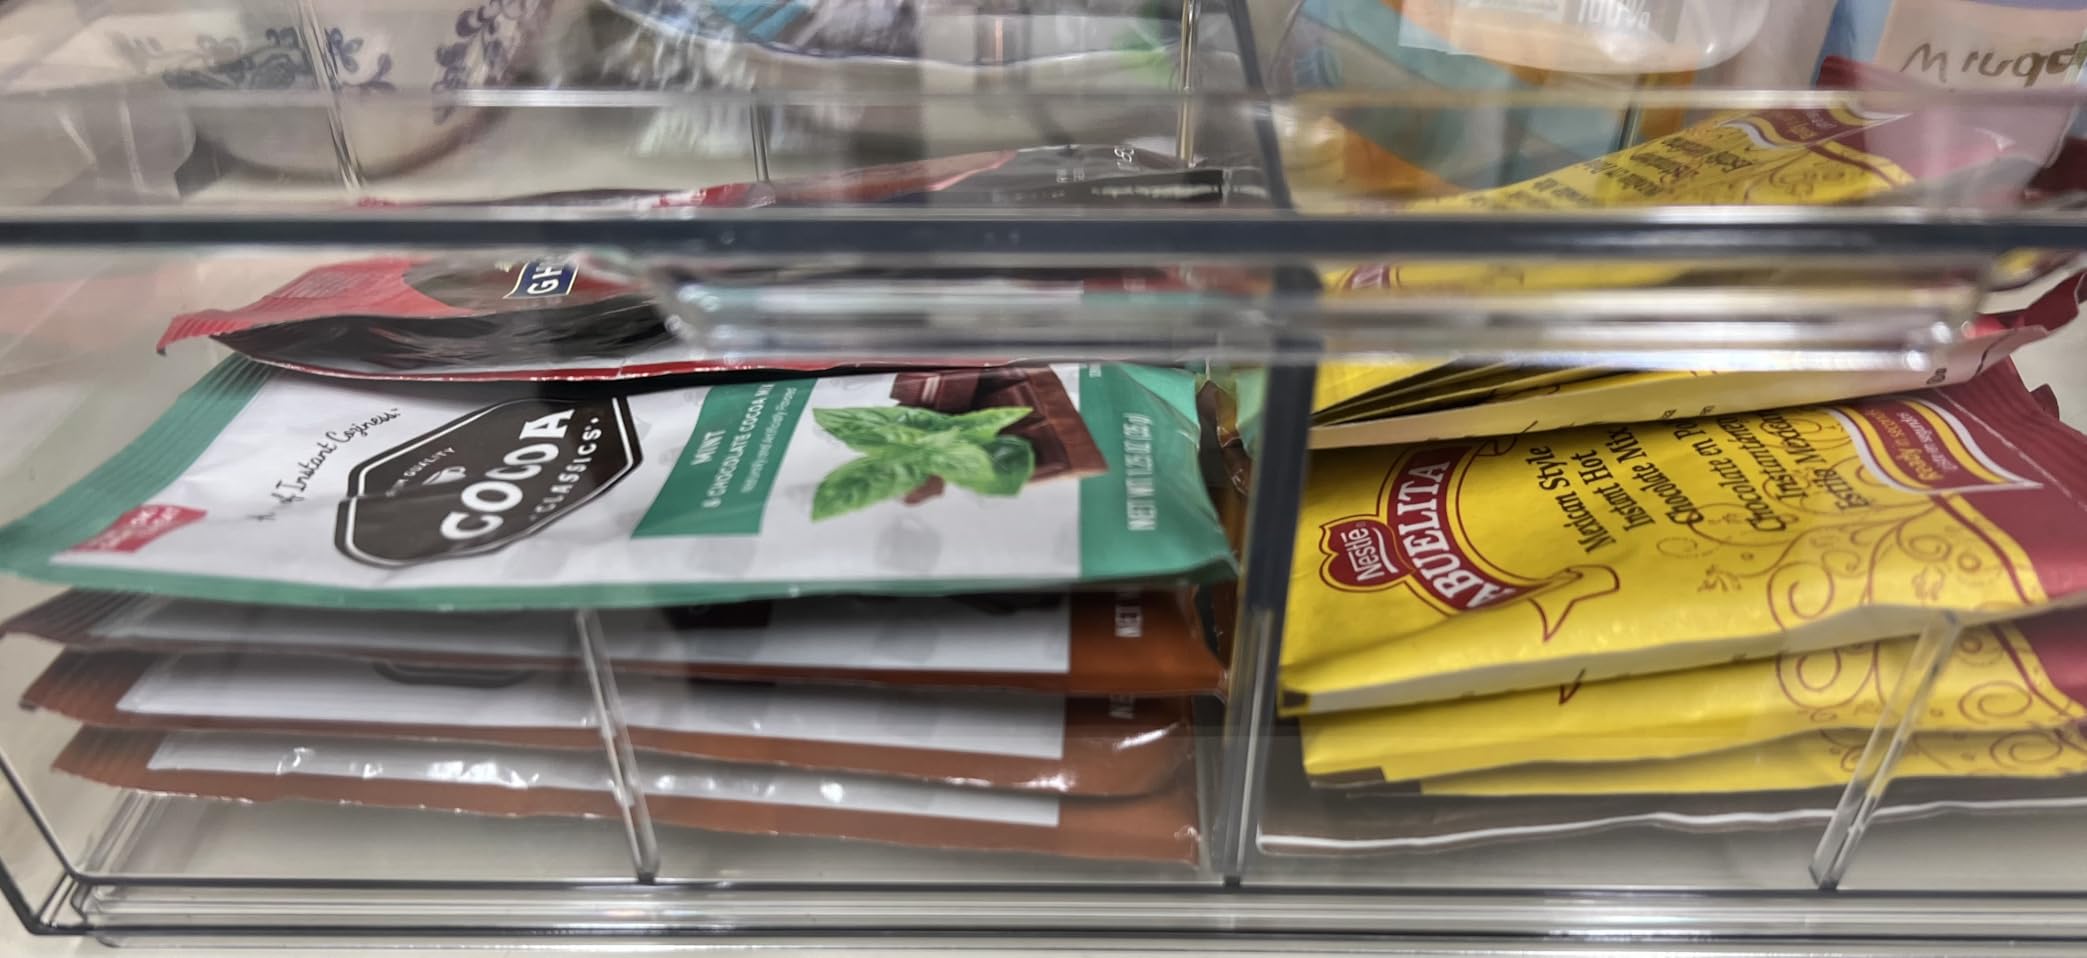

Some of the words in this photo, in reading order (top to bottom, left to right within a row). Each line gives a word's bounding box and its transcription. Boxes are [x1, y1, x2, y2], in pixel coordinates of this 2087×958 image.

[275, 441, 337, 492] Instant
[535, 425, 602, 514] CLASSICS
[690, 430, 727, 465] MINT
[707, 433, 752, 497] CHOCOLATE
[739, 398, 767, 432] COCOA
[1525, 446, 1570, 491] Style
[1571, 449, 1614, 485] Hot
[1605, 427, 1647, 463] Mix
[1692, 438, 1723, 456] en
[440, 408, 576, 540] COCOA
[1631, 462, 1704, 525] Chocolate
[1709, 457, 1786, 532] Chocolate
[1813, 468, 1871, 511] Estilo
[1555, 491, 1617, 553] Mexican
[1593, 482, 1656, 531] Instant
[1397, 462, 1517, 608] ABUELITA
